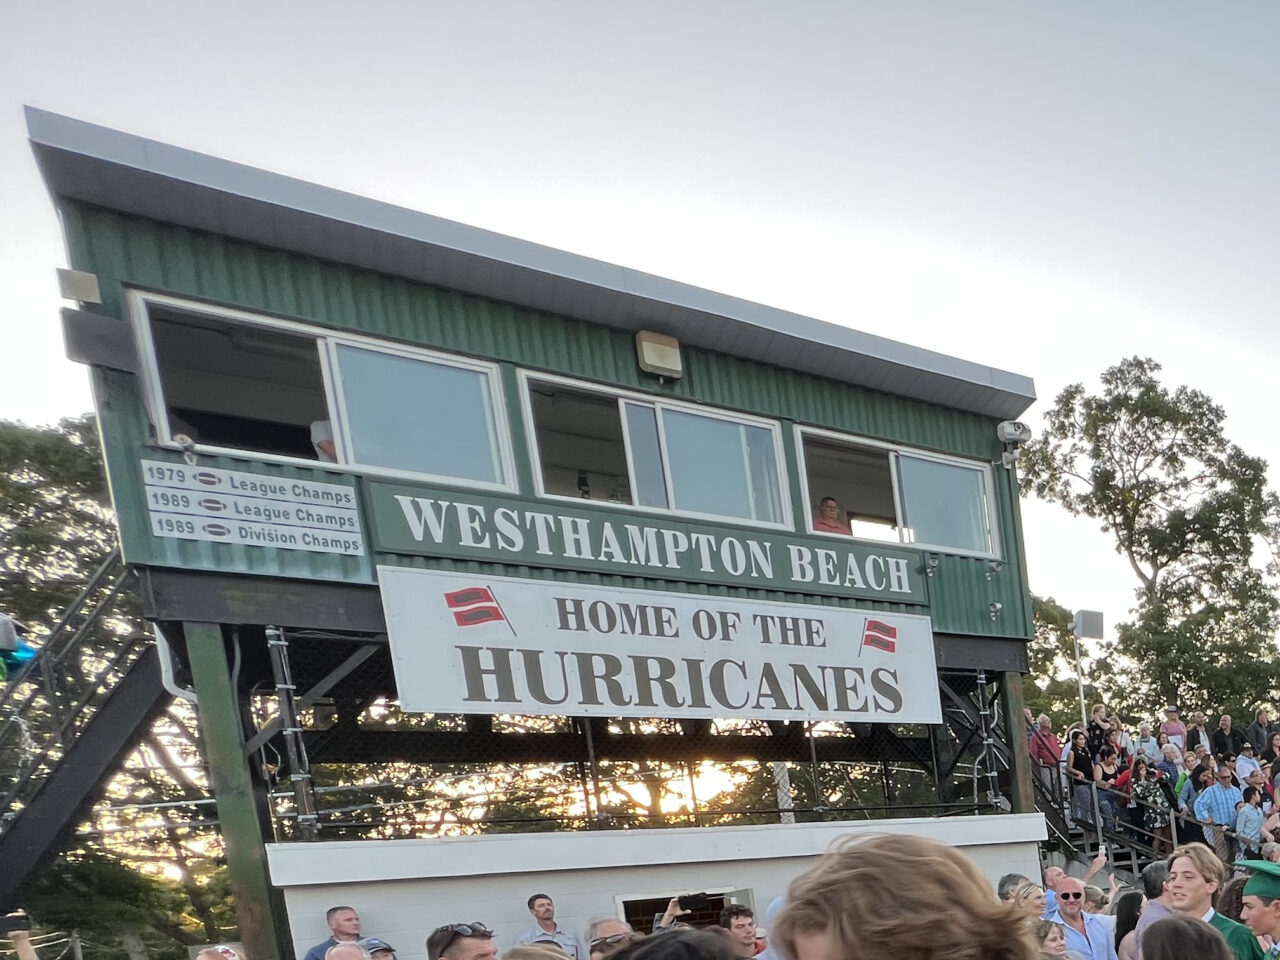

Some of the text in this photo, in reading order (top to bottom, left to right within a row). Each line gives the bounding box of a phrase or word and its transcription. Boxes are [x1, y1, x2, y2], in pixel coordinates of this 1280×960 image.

[147, 466, 351, 504] 1979 League Champs
[152, 492, 355, 528] 1989 League Champs
[157, 518, 359, 551] 1989 Division Champs
[394, 495, 911, 594] WESTHAMPTON BEACH
[553, 597, 827, 648] HOME OF THE
[455, 646, 903, 714] HURRICANES
